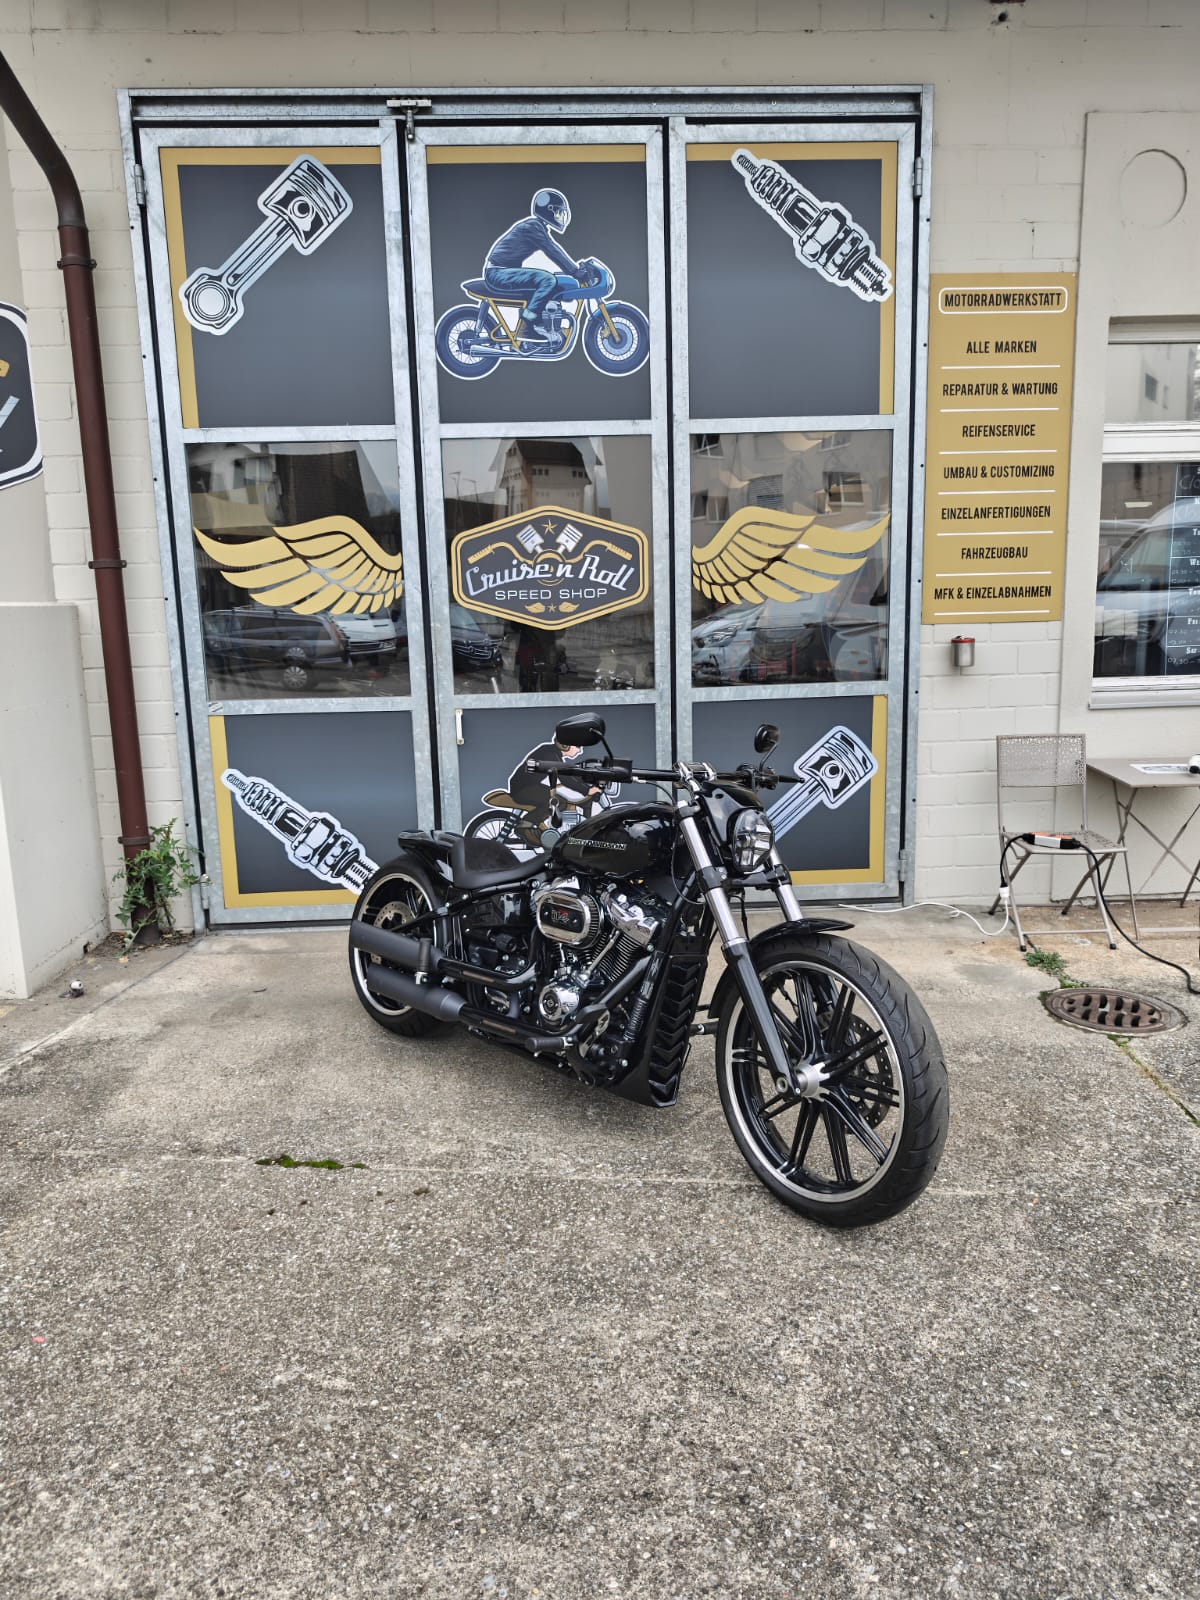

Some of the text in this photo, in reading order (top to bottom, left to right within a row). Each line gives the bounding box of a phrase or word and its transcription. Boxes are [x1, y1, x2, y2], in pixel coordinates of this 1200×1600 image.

[944, 292, 1062, 307] MOTORRADWERKSTATT
[966, 340, 1037, 354] ALLE MARKEN
[942, 382, 1058, 396] REPARATUR & WARTUNG
[962, 424, 1036, 438] REIFENSERVICE
[943, 465, 1055, 479] UMBAU & CUSTOMIZING
[941, 505, 1051, 520] EINZELANFERTIGUNGEN
[961, 546, 1028, 560] FAHRZEUGBAU
[465, 553, 635, 597] Cruise n Roll
[495, 588, 608, 600] SPEED SHOP
[934, 585, 1052, 600] MFK & EINZELABNAHMEN
